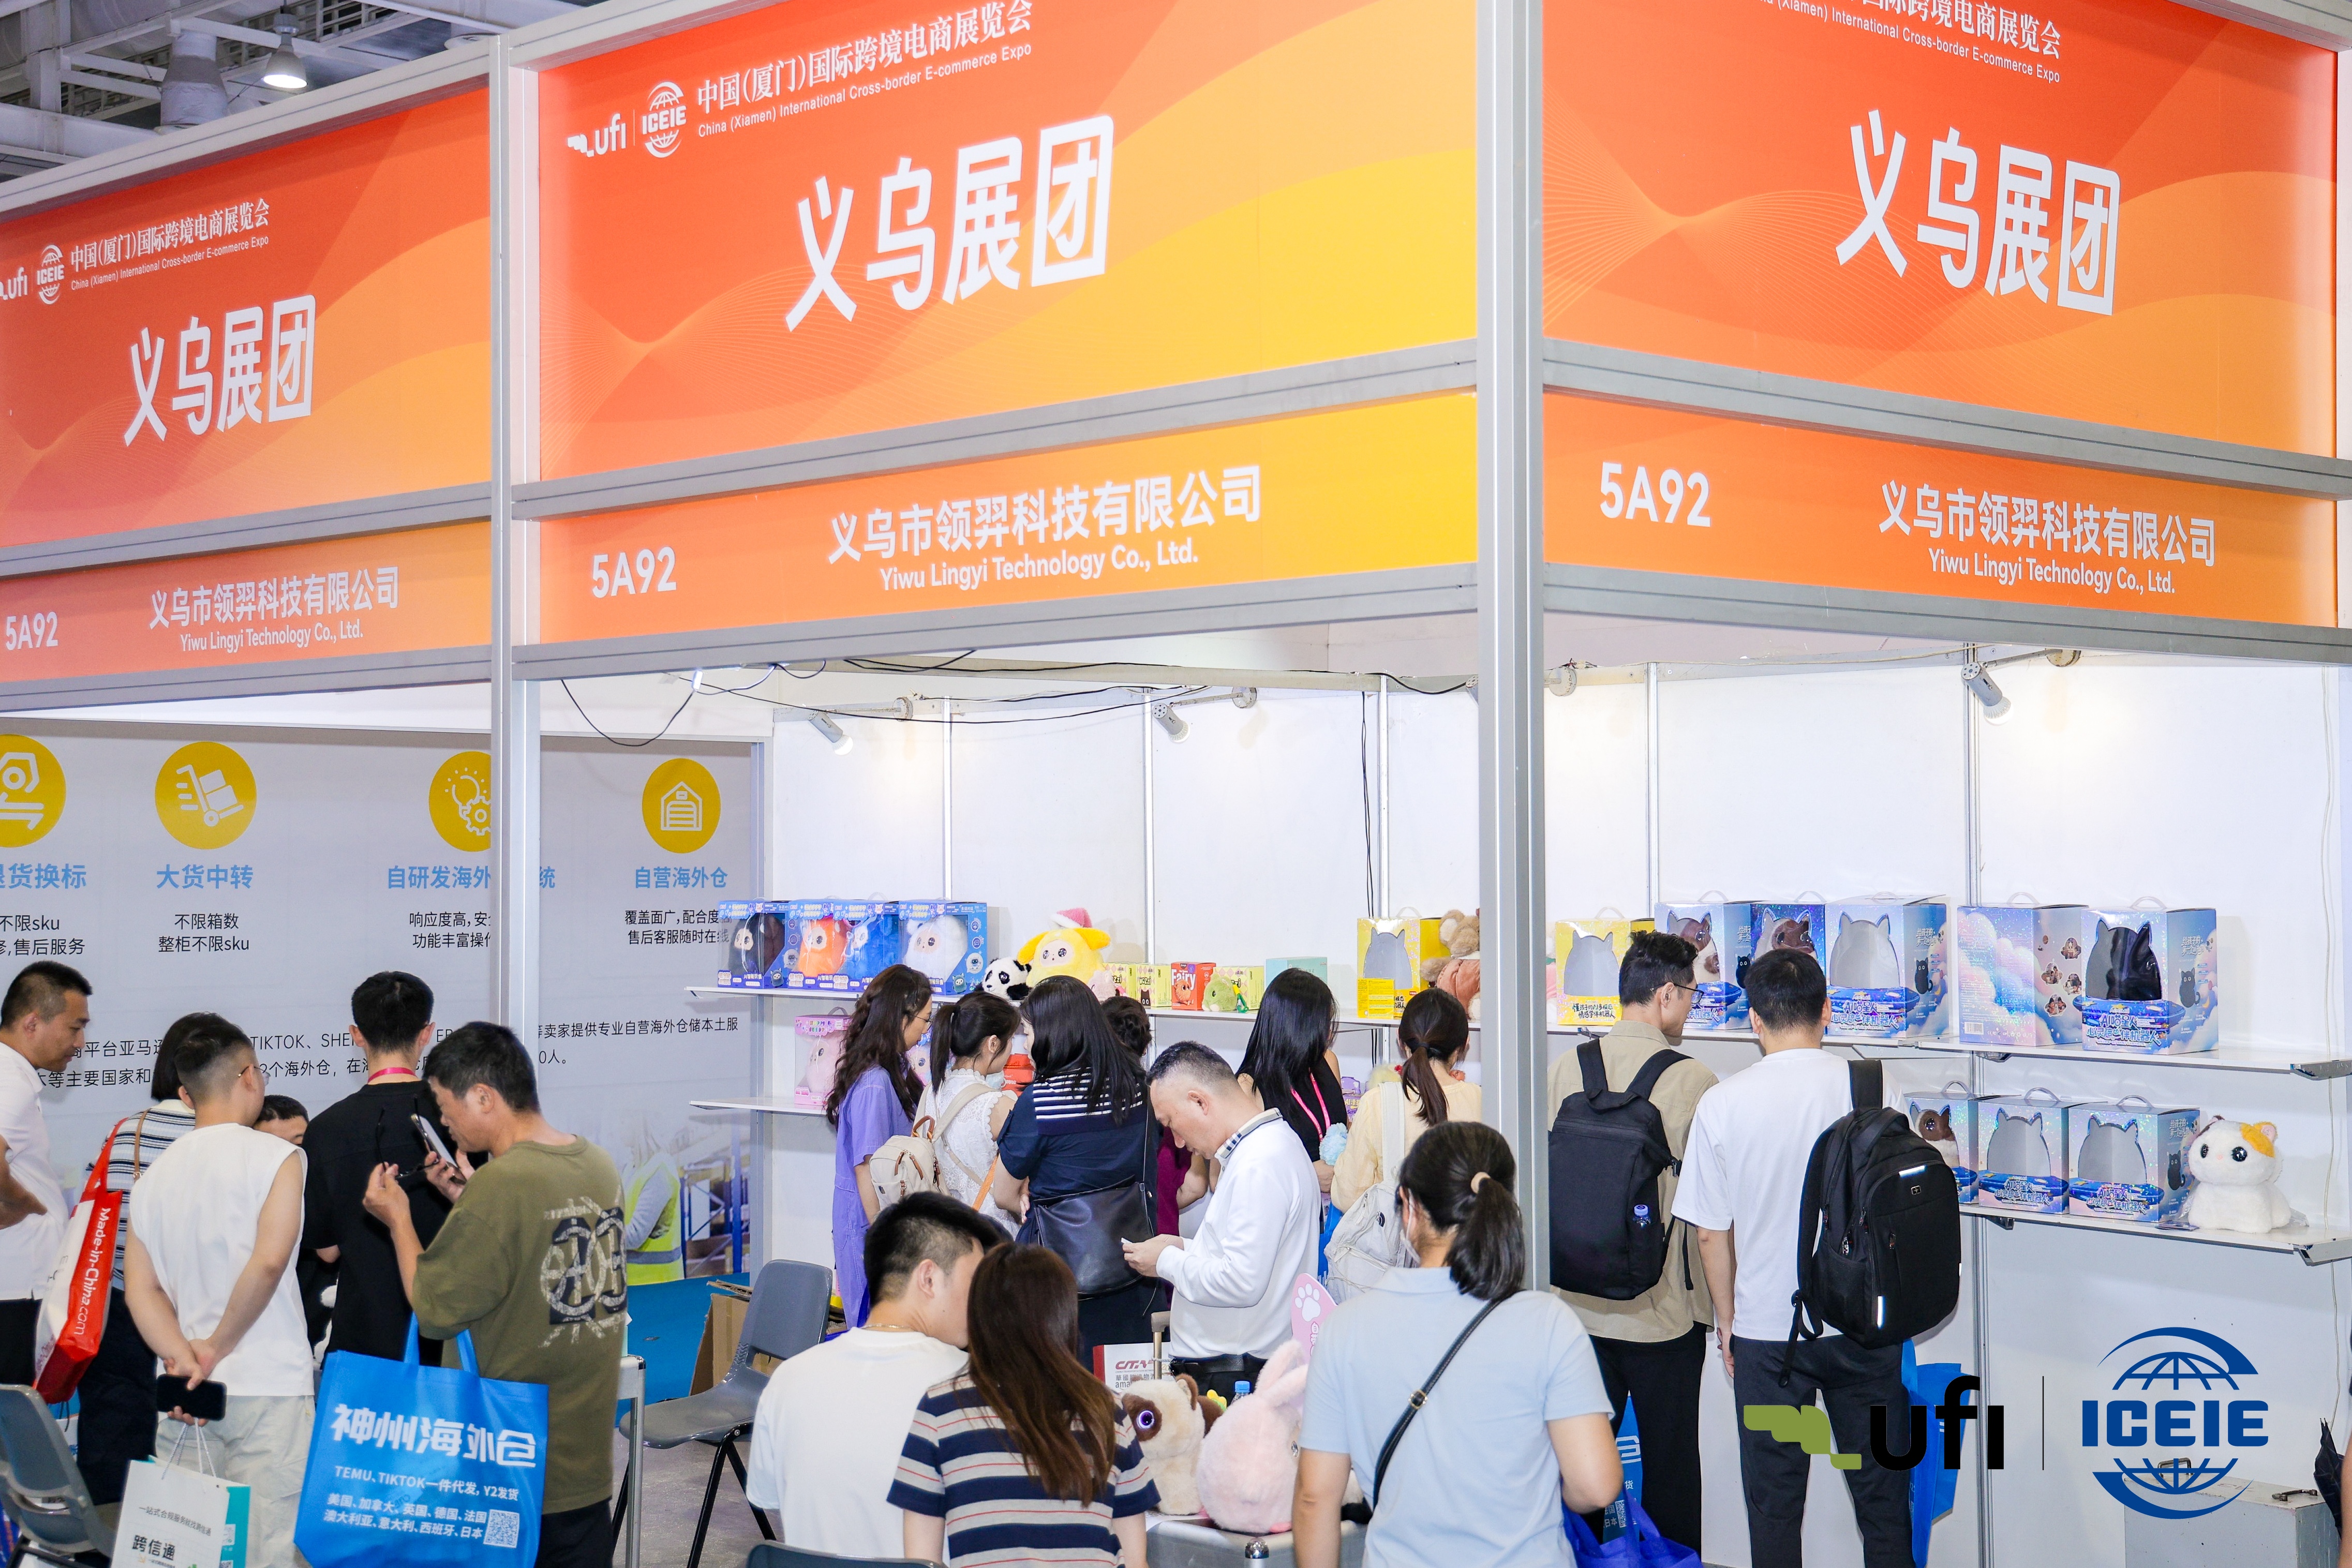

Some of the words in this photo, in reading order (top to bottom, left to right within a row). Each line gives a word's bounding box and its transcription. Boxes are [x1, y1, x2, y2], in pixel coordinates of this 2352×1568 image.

[1832, 7, 1899, 39] International
[1903, 27, 1969, 57] Cross-border
[1973, 46, 2033, 75] E-commerce
[2036, 64, 2060, 84] Expo
[1863, 0, 2061, 59] 跨境电商展览会
[697, 0, 1032, 114] 中国(厦门)国际跨境电商展览会
[698, 121, 727, 138] China
[731, 107, 776, 132] (Xiamen)
[780, 88, 845, 117] International
[850, 70, 921, 99] Cross-border
[926, 53, 996, 80] E-commerce
[1002, 42, 1032, 62] Expo
[595, 113, 626, 155] ufi
[642, 105, 687, 135] ICEIE
[71, 198, 269, 272] 中国(厦门)国际跨境电商展览会
[785, 115, 1113, 332] 义乌展团
[1835, 109, 2120, 315] 义乌展团
[37, 264, 65, 285] ICEIE
[71, 278, 89, 291] China
[91, 273, 118, 288] (Xiamen)
[121, 262, 160, 278] International
[162, 251, 204, 268] Cross-border
[207, 242, 249, 259] E-commerce
[251, 235, 269, 249] Expo
[124, 294, 316, 446] 义乌展团
[828, 465, 1261, 565] 义乌市领羿科技有限公司
[1599, 461, 1711, 528] 5A92
[1879, 480, 2215, 567] 义乌市领羿科技有限公司
[591, 546, 677, 599] 5A92
[880, 565, 926, 591] Yiwu
[931, 561, 988, 591] Lingyi
[992, 550, 1107, 583] Technology
[1111, 544, 1152, 572] Co.,
[1157, 537, 1199, 565] Ltd.
[1928, 547, 1968, 575] Yiwu
[1975, 552, 2023, 586] Lingyi
[2026, 558, 2112, 595] Technology
[2117, 566, 2145, 594] Co.,
[2149, 570, 2176, 594] Ltd.
[150, 566, 399, 630] 义乌市领羿科技有限公司
[6, 611, 58, 651] 5A92
[181, 632, 207, 652] Yiwu
[211, 630, 244, 654] Lingyi
[246, 624, 311, 649] Technology
[314, 622, 337, 644] Co.,
[340, 618, 364, 639] Ltd.
[0, 863, 87, 889] 货换标
[156, 864, 254, 889] 大货中转
[635, 866, 728, 888] 自营海外仓
[0, 915, 59, 932] 不限sku
[158, 936, 249, 952] 整柜不限sku
[174, 913, 239, 930] 不限箱数
[409, 912, 490, 928] 响应度高，安
[74, 1207, 111, 1335] Made-in-China.com
[331, 1403, 536, 1468] 神州海外仓
[132, 1534, 175, 1561] 跨信通
